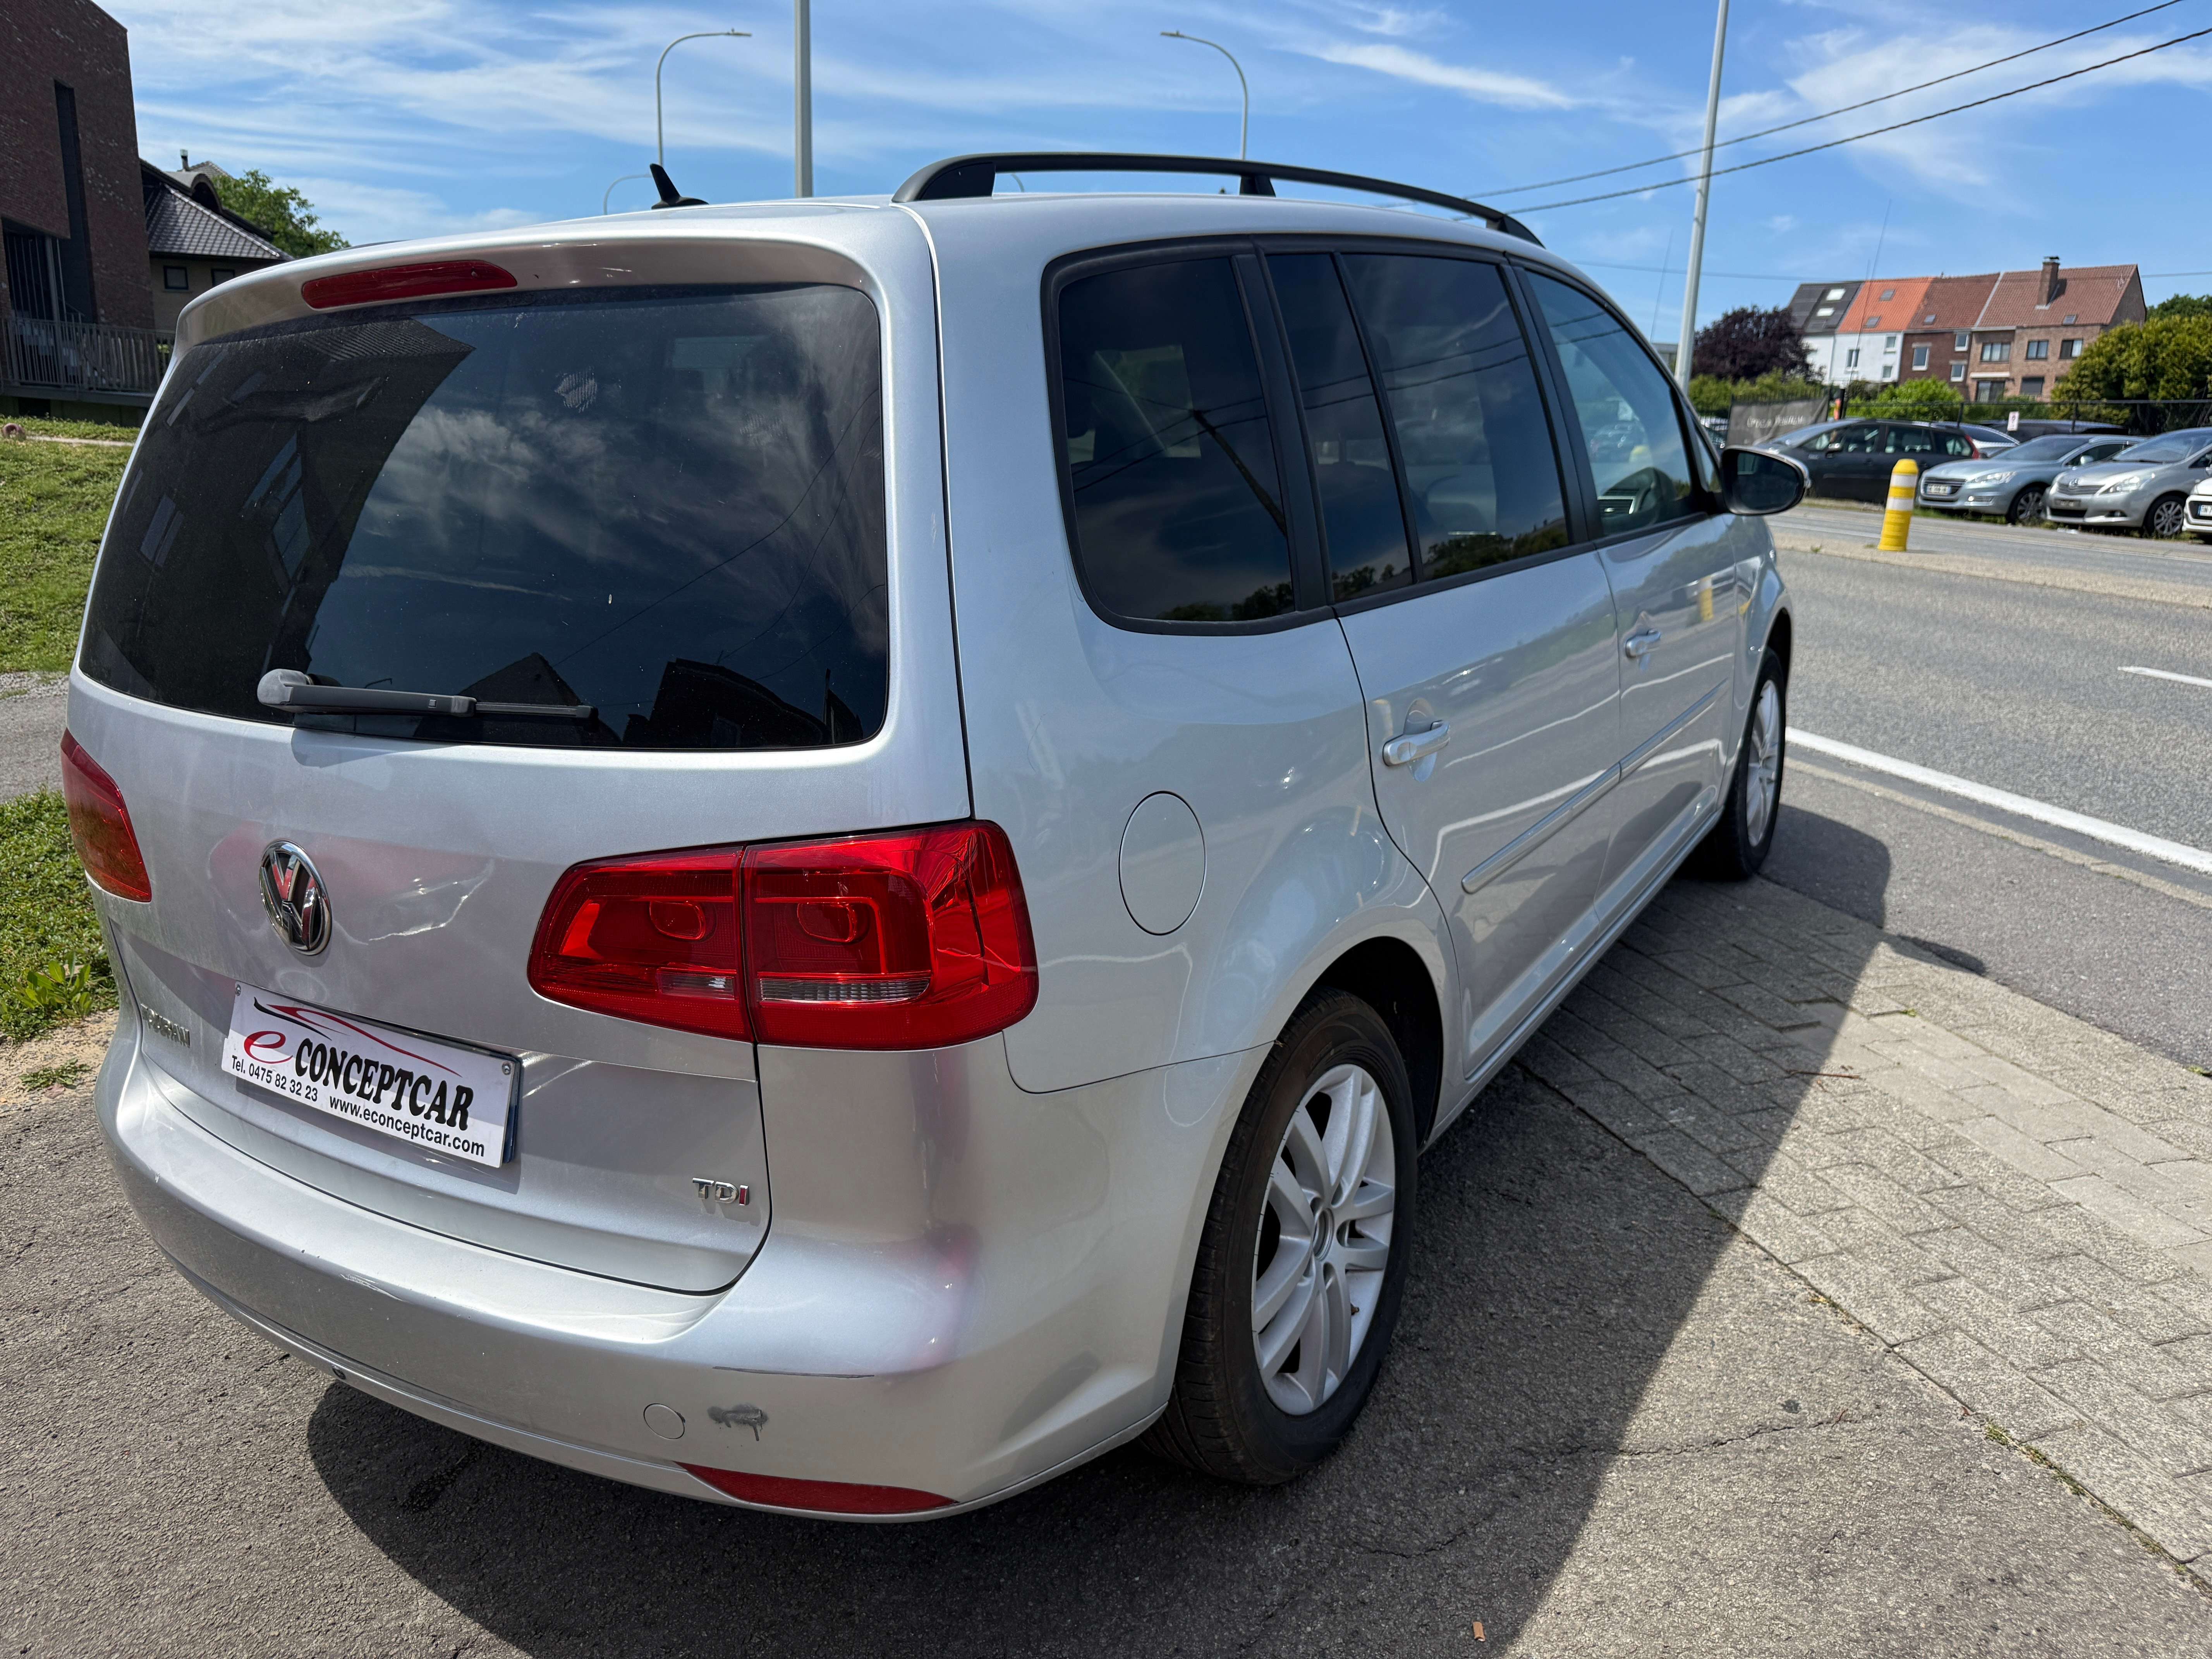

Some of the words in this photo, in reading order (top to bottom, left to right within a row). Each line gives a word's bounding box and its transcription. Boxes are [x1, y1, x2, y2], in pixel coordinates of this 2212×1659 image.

[232, 1054, 246, 1074] Tel.
[249, 1063, 273, 1084] 0475
[275, 1073, 287, 1090] 82
[289, 1079, 302, 1096] 32
[304, 1085, 318, 1102] 23
[329, 1096, 485, 1157] www.econceptcar.com
[295, 1038, 474, 1131] CONCEPTCAR
[692, 1177, 750, 1206] TDI
